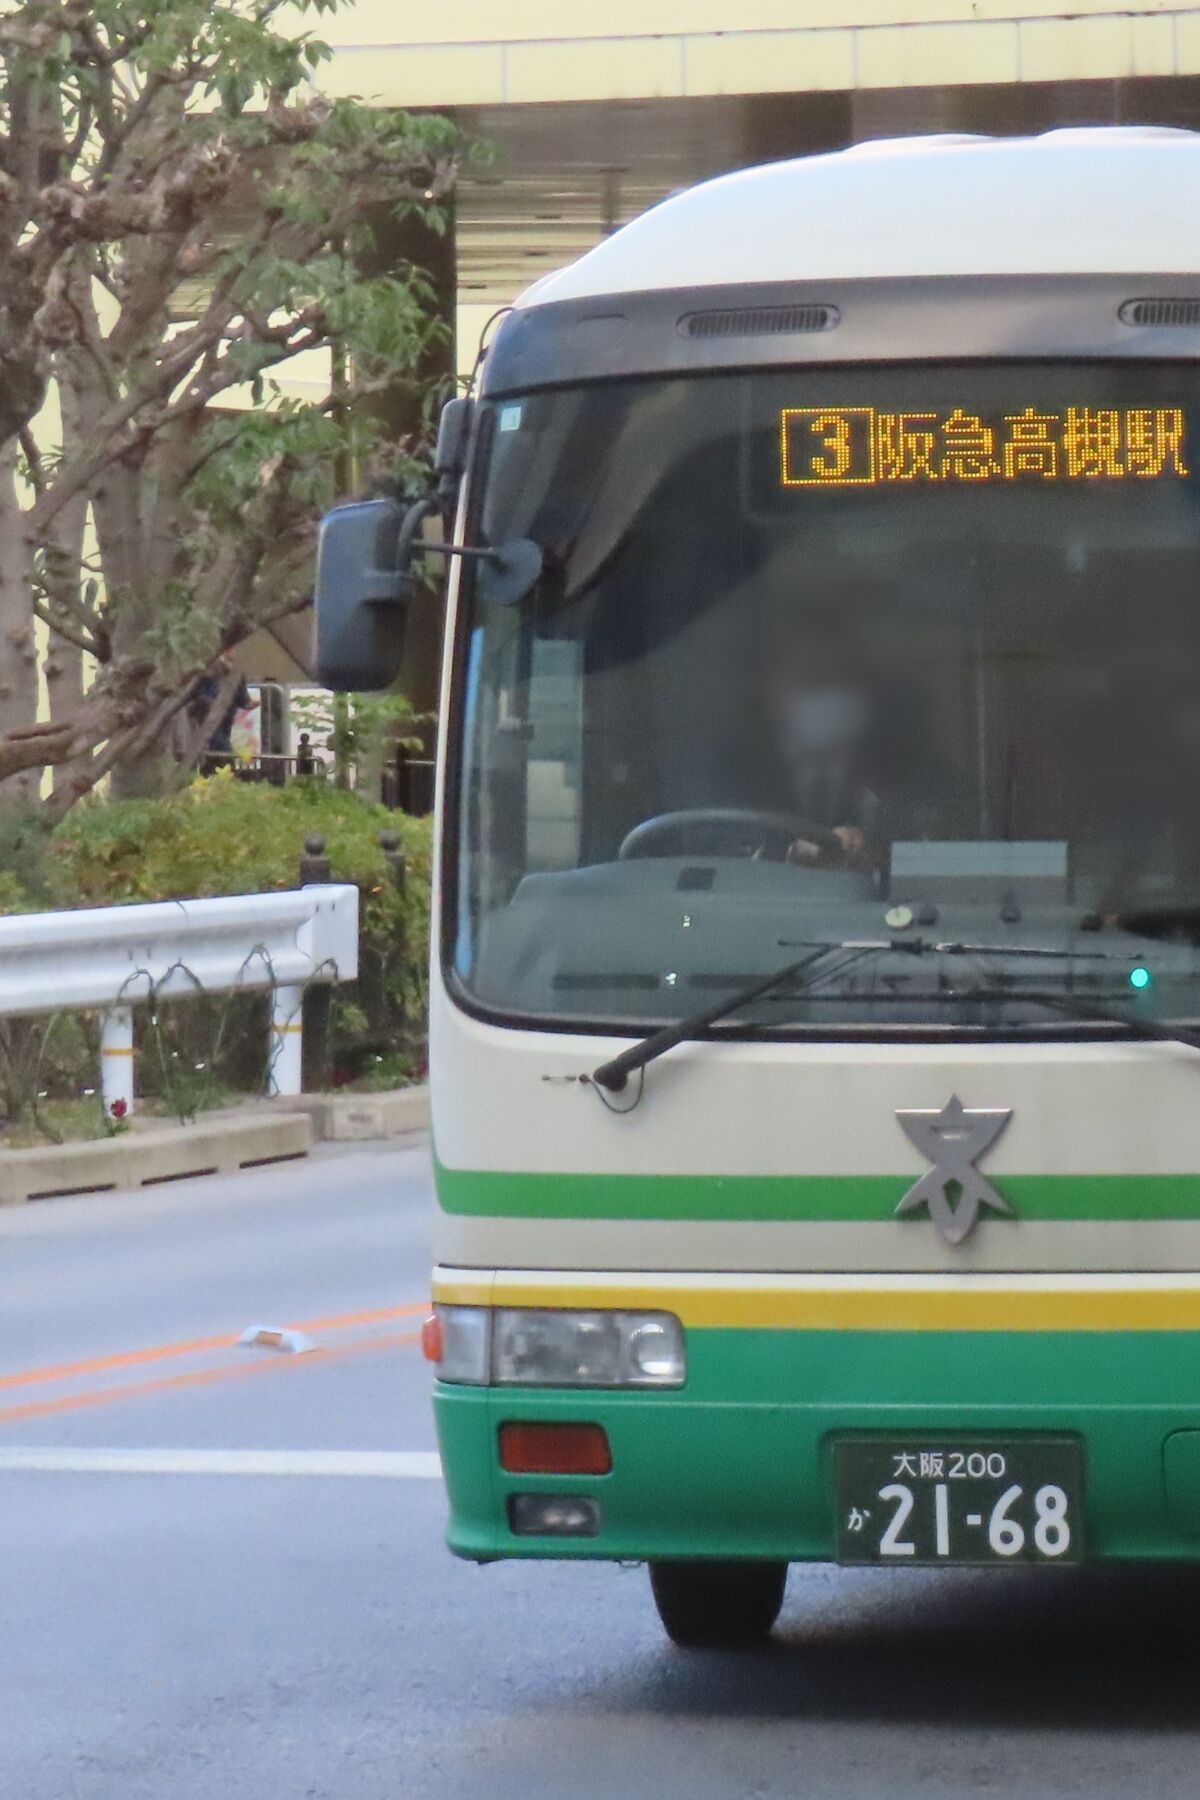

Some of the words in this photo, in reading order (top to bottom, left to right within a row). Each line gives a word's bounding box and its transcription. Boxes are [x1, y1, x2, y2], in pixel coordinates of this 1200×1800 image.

[810, 415, 851, 477] 3
[877, 407, 1190, 480] 阪急高槻駅
[847, 1506, 871, 1532] か
[877, 1483, 1071, 1557] 21-68
